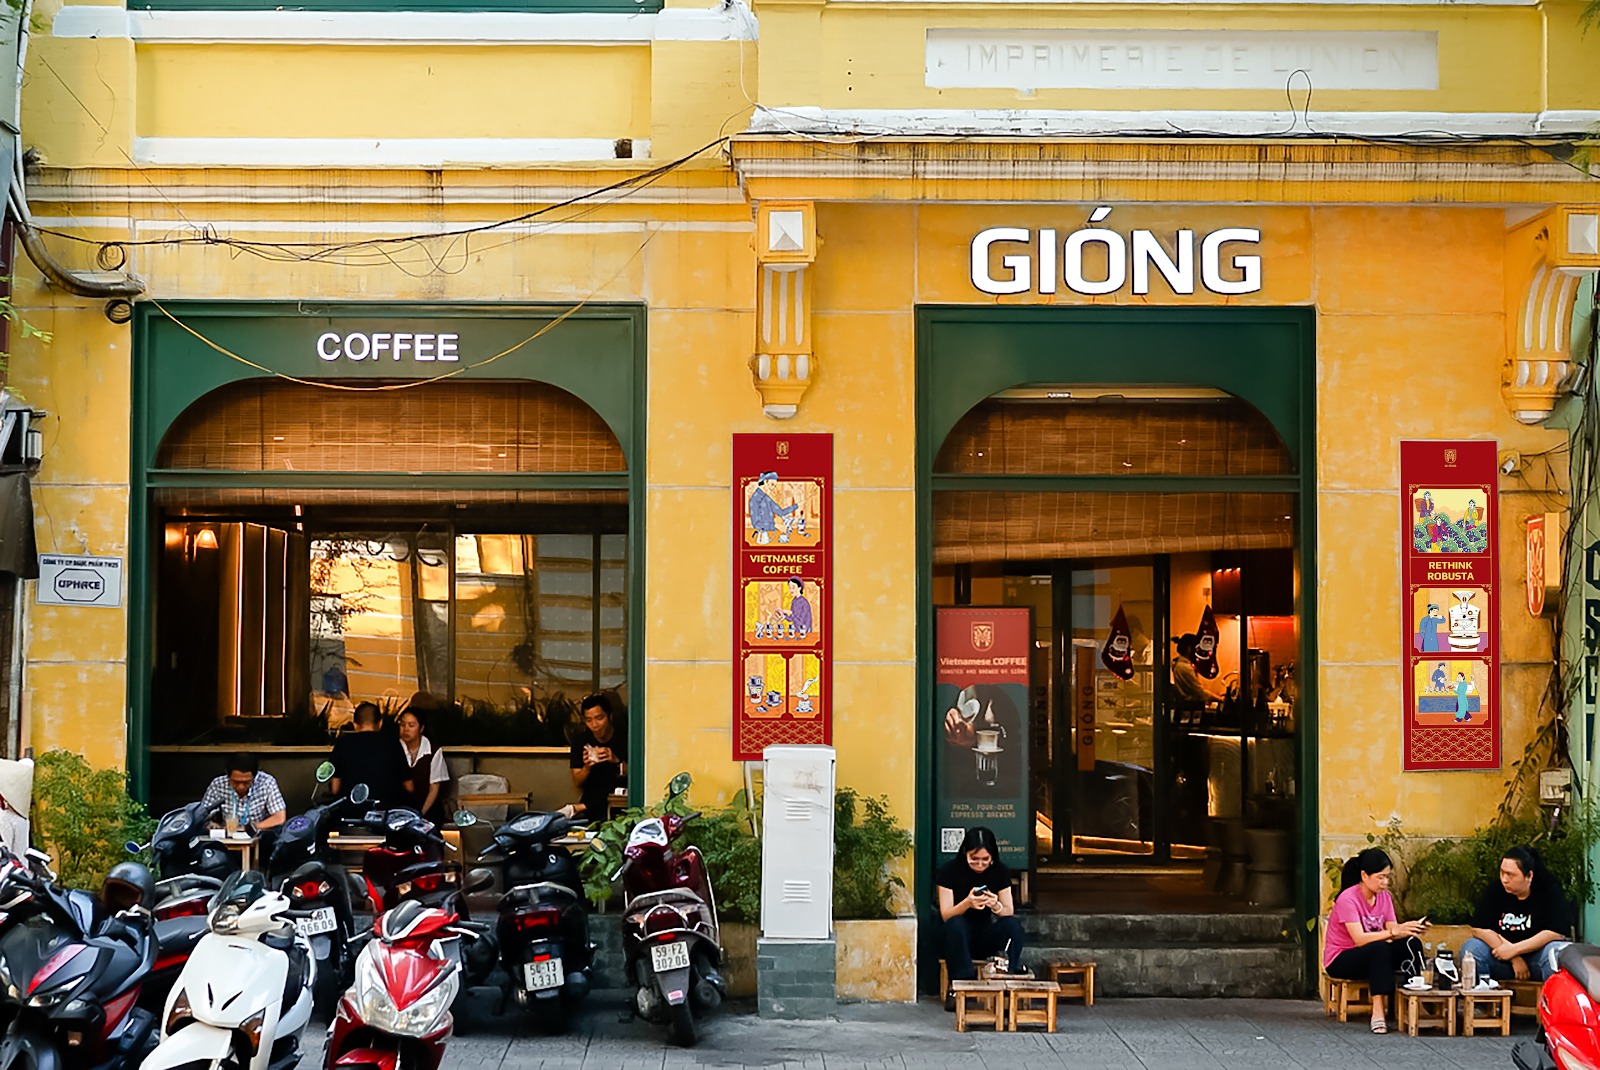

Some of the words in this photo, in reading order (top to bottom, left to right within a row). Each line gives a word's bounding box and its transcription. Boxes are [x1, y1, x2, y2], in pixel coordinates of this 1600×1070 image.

[966, 44, 1183, 73] IMPRIMERIE
[970, 205, 1262, 295] GIÓNG
[316, 332, 459, 361] COFFEE
[749, 554, 816, 563] VIETNAMESE
[762, 565, 803, 574] COFFEE
[1428, 561, 1473, 570] RETHINK
[1427, 572, 1474, 580] ROBUSTA
[58, 580, 100, 589] UPHACE
[940, 657, 991, 666] Vietnamese
[992, 656, 1027, 666] COFFEE
[655, 943, 683, 958] 59-F2
